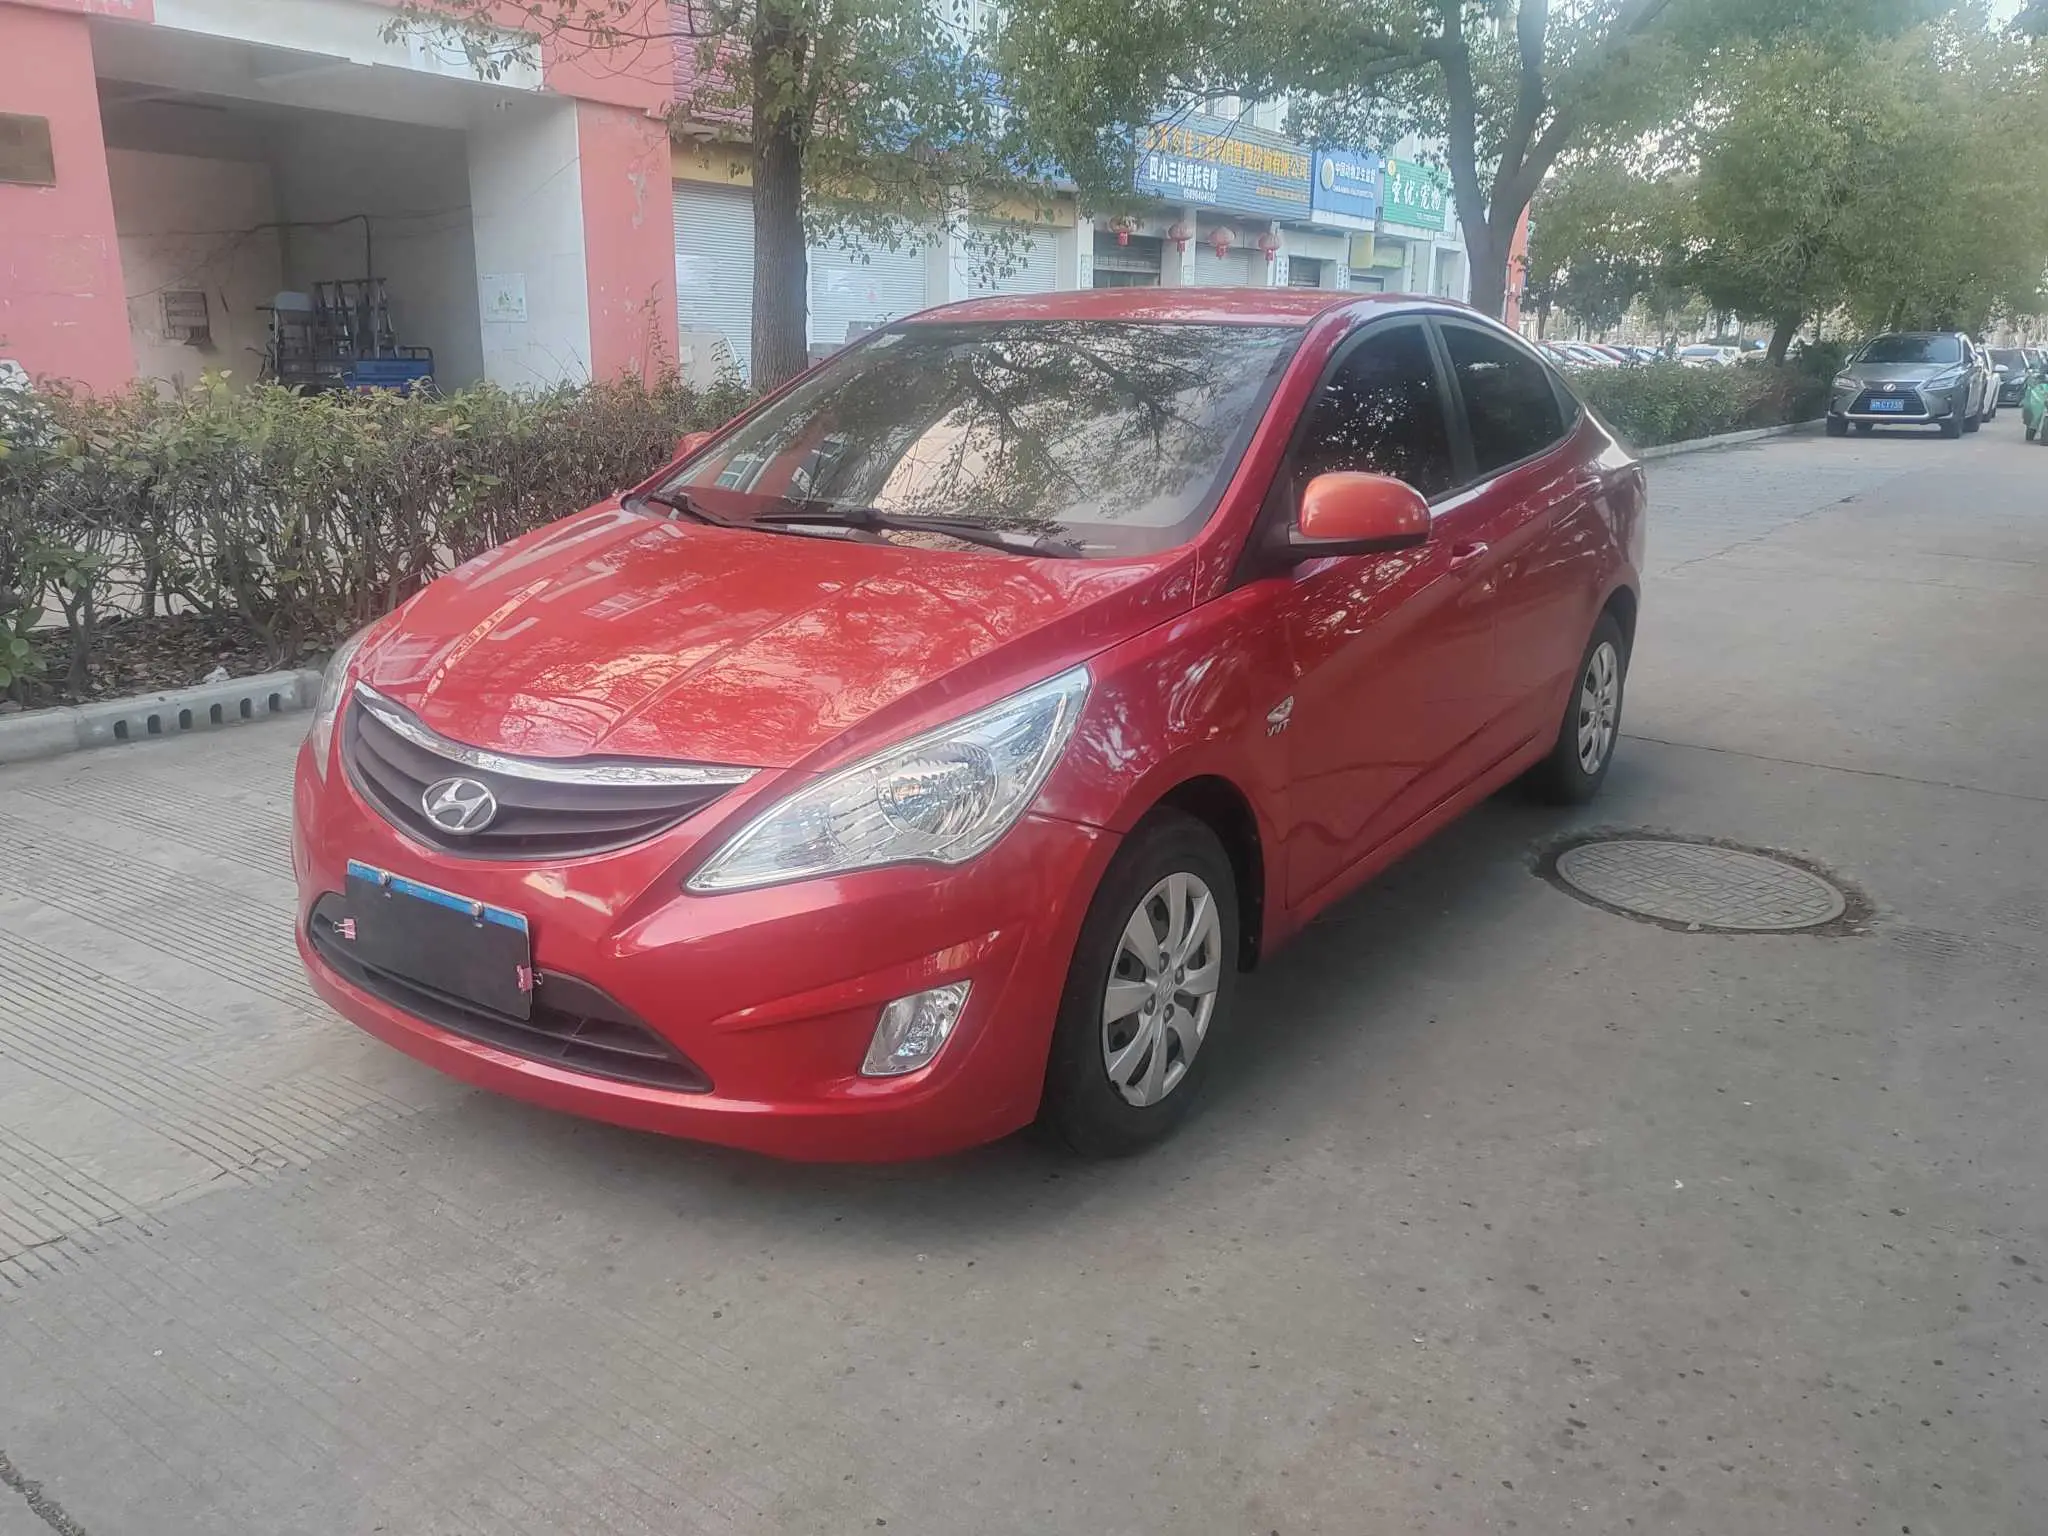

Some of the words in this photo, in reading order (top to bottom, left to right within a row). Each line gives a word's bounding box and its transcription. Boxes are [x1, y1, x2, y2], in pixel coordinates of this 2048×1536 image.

[1149, 156, 1218, 190] 四小三轮摩托专修
